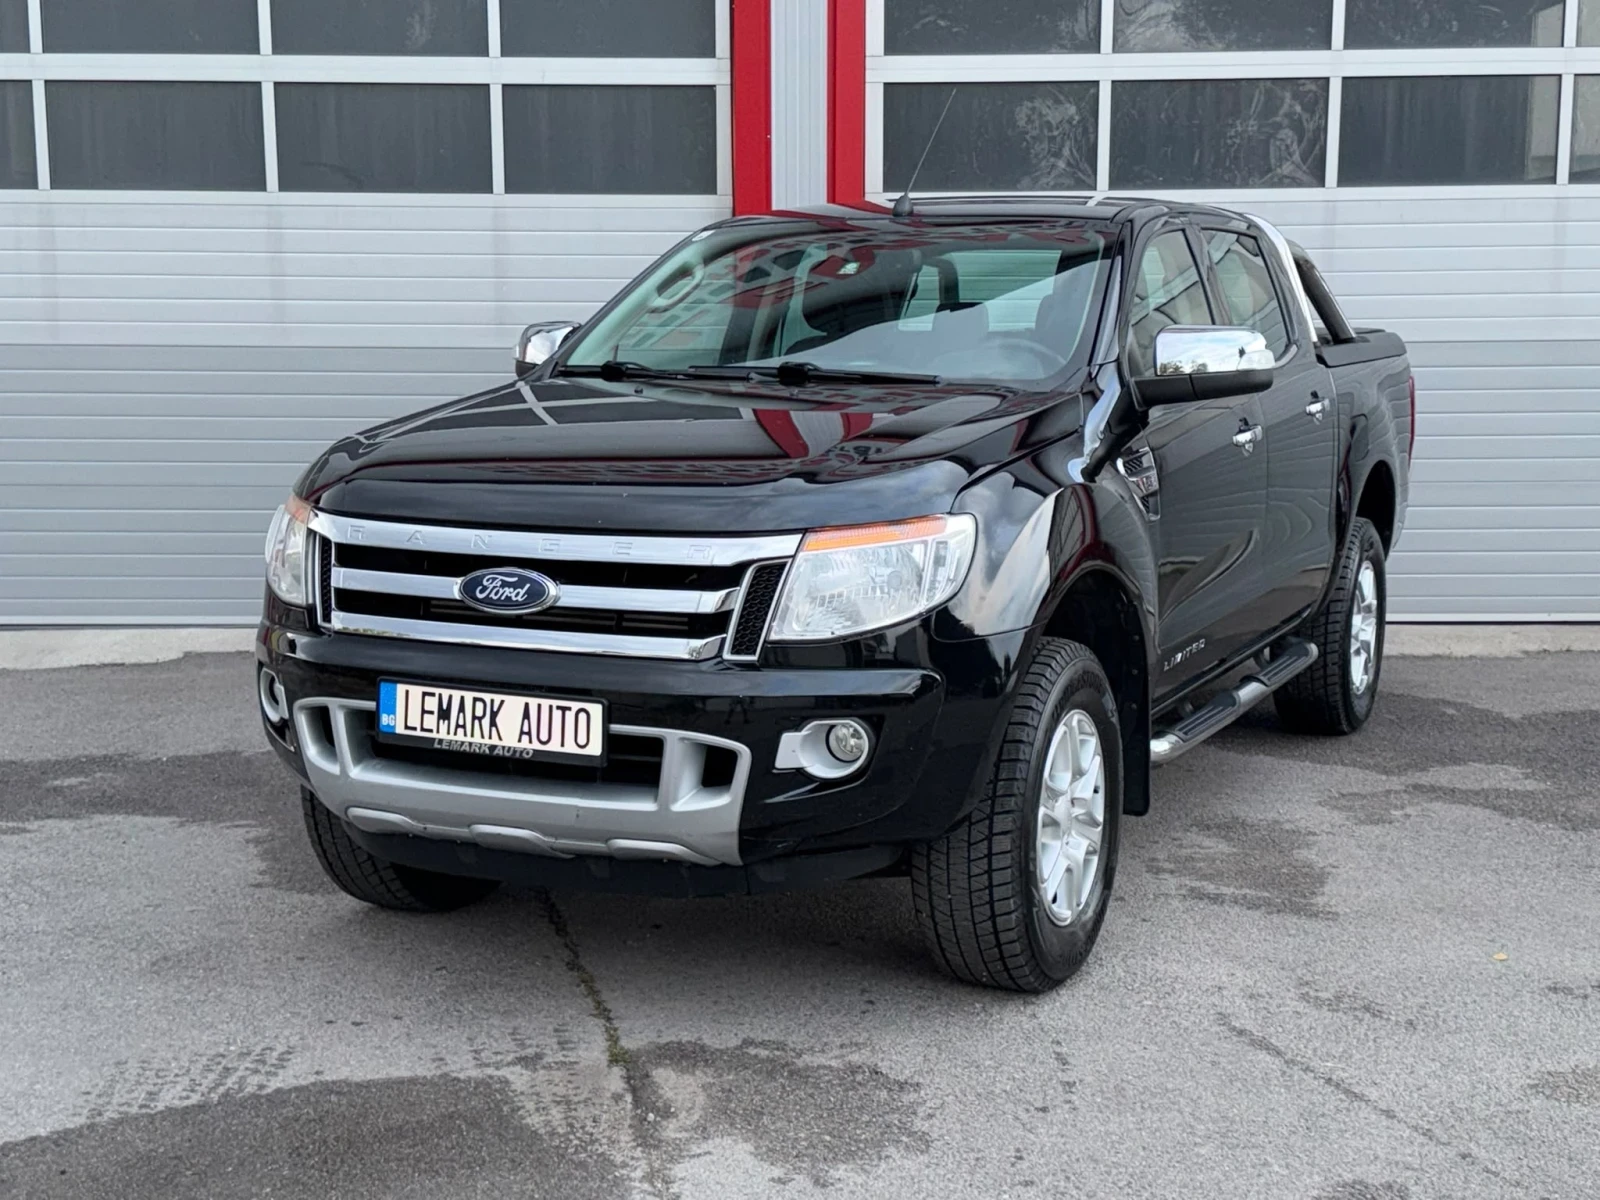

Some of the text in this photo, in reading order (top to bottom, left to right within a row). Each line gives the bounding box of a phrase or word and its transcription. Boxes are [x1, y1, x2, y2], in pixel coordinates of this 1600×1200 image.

[347, 525, 712, 560] RANGER
[475, 573, 531, 602] Ford
[381, 713, 396, 726] BG
[403, 689, 591, 749] LEMARK AUTO
[433, 738, 534, 759] LEMARK AUTO
